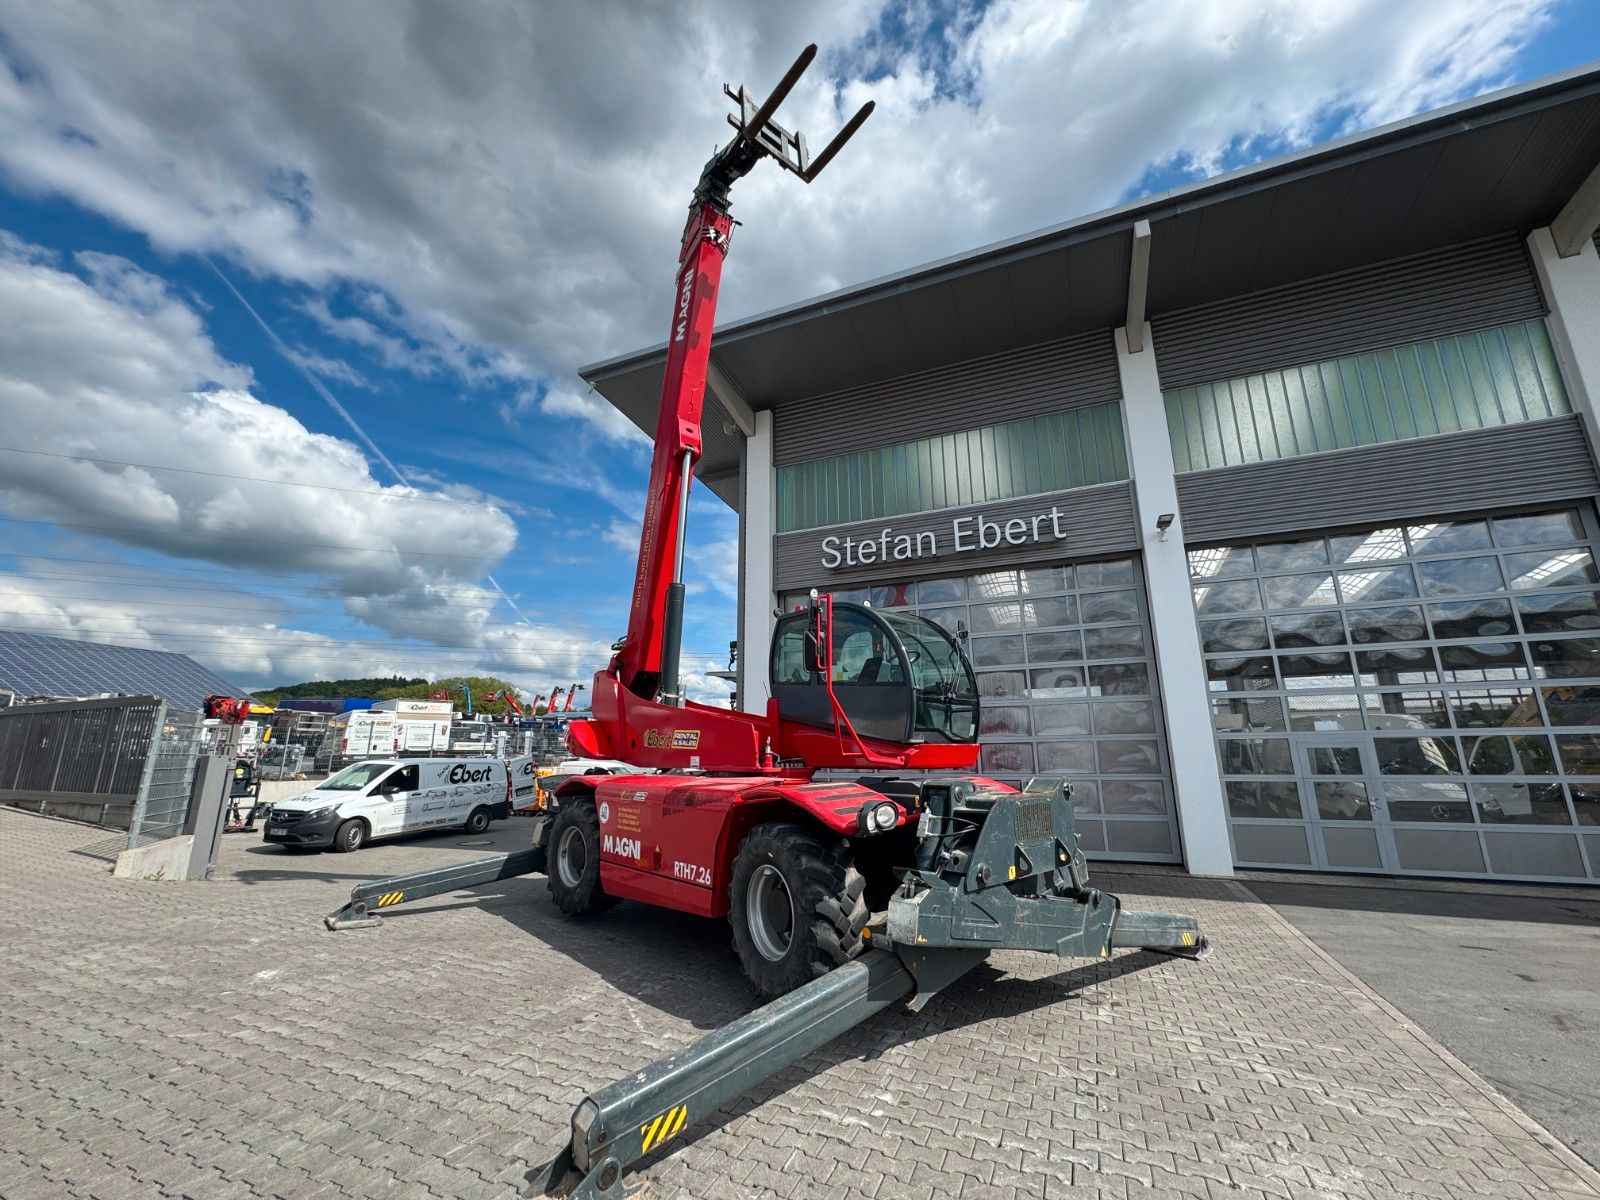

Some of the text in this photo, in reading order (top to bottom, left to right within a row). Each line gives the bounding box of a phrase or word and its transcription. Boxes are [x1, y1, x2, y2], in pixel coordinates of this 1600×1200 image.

[675, 268, 694, 342] MAGNI
[643, 530, 651, 552] man
[821, 506, 1067, 569] Stefan Ebert
[639, 556, 648, 580] kann
[635, 582, 643, 608] mich
[449, 763, 492, 785] Ebert
[603, 834, 641, 860] MAGNI
[673, 860, 712, 886] RTH7.26
